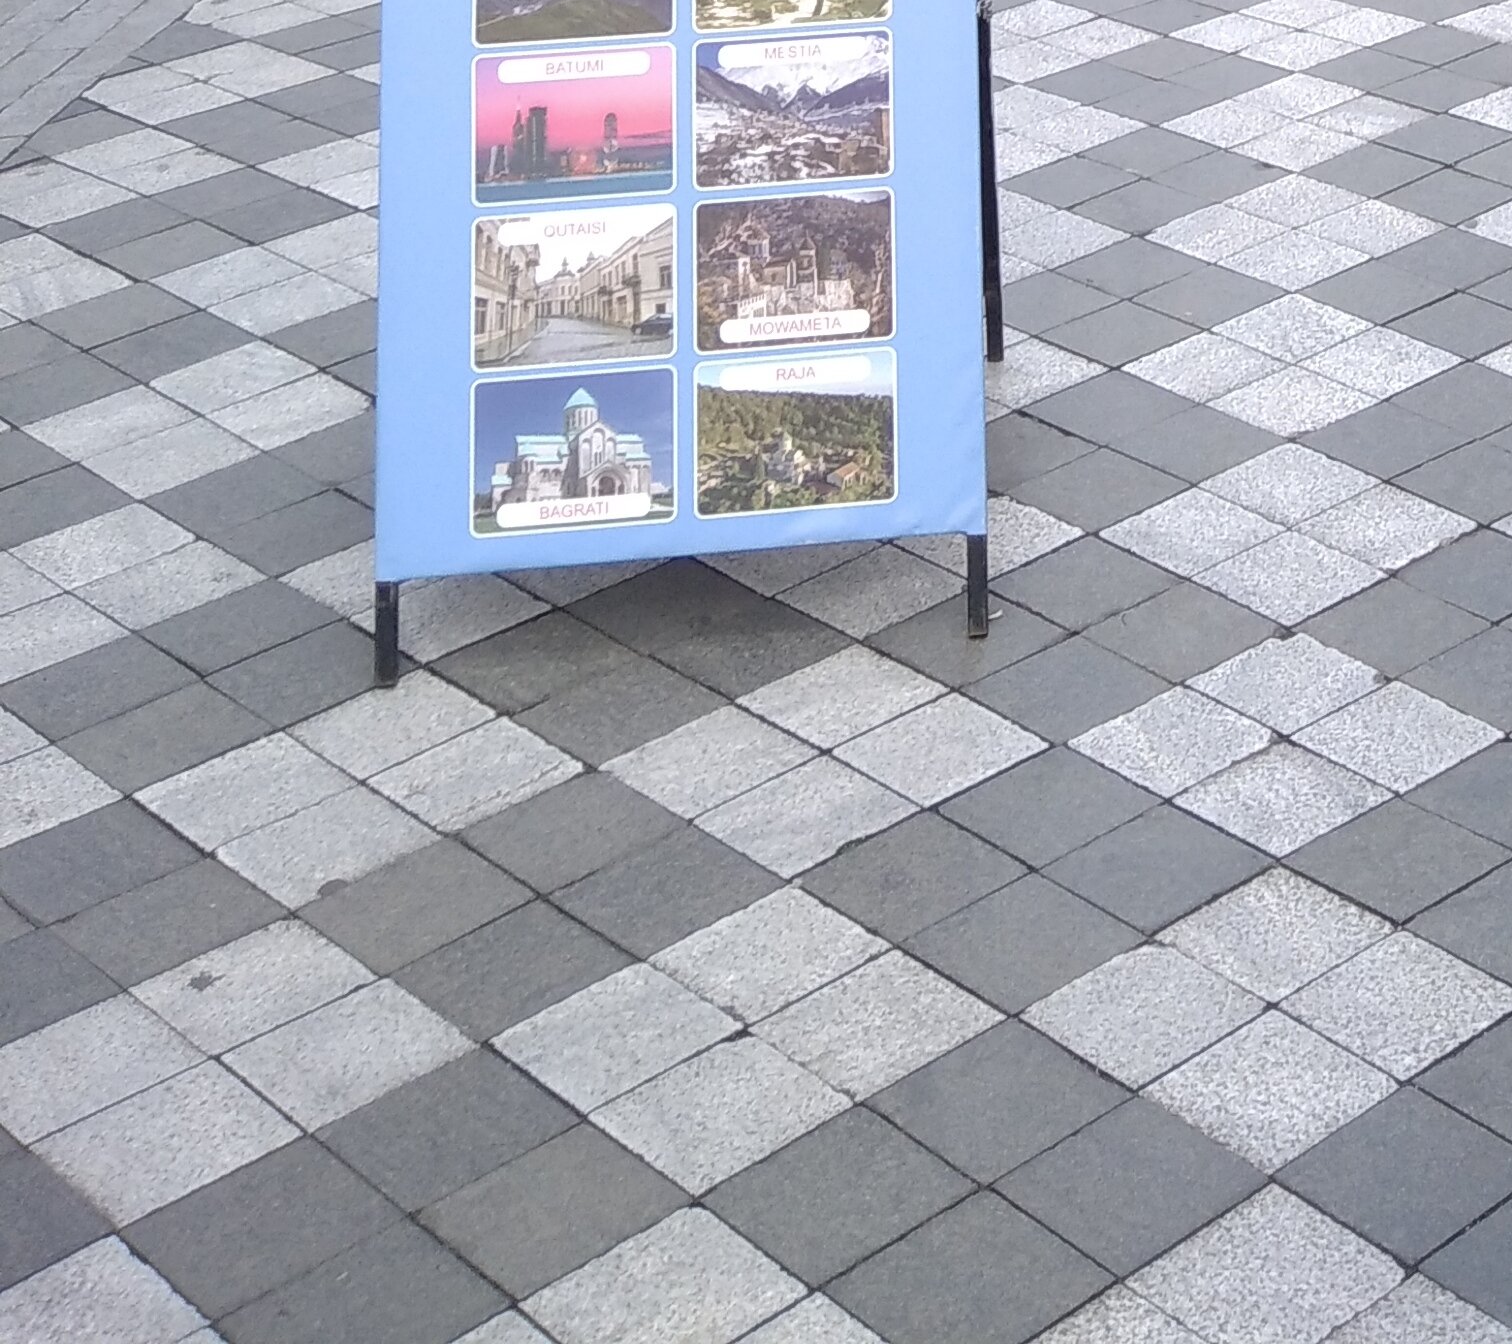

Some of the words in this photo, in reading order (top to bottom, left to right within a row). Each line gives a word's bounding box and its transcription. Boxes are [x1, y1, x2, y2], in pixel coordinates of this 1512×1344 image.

[764, 44, 822, 60] MESTIA
[545, 59, 604, 75] BATUMI
[749, 316, 842, 336] MOWAMETA
[776, 366, 816, 382] RAJA
[539, 501, 609, 520] BAGRATI
